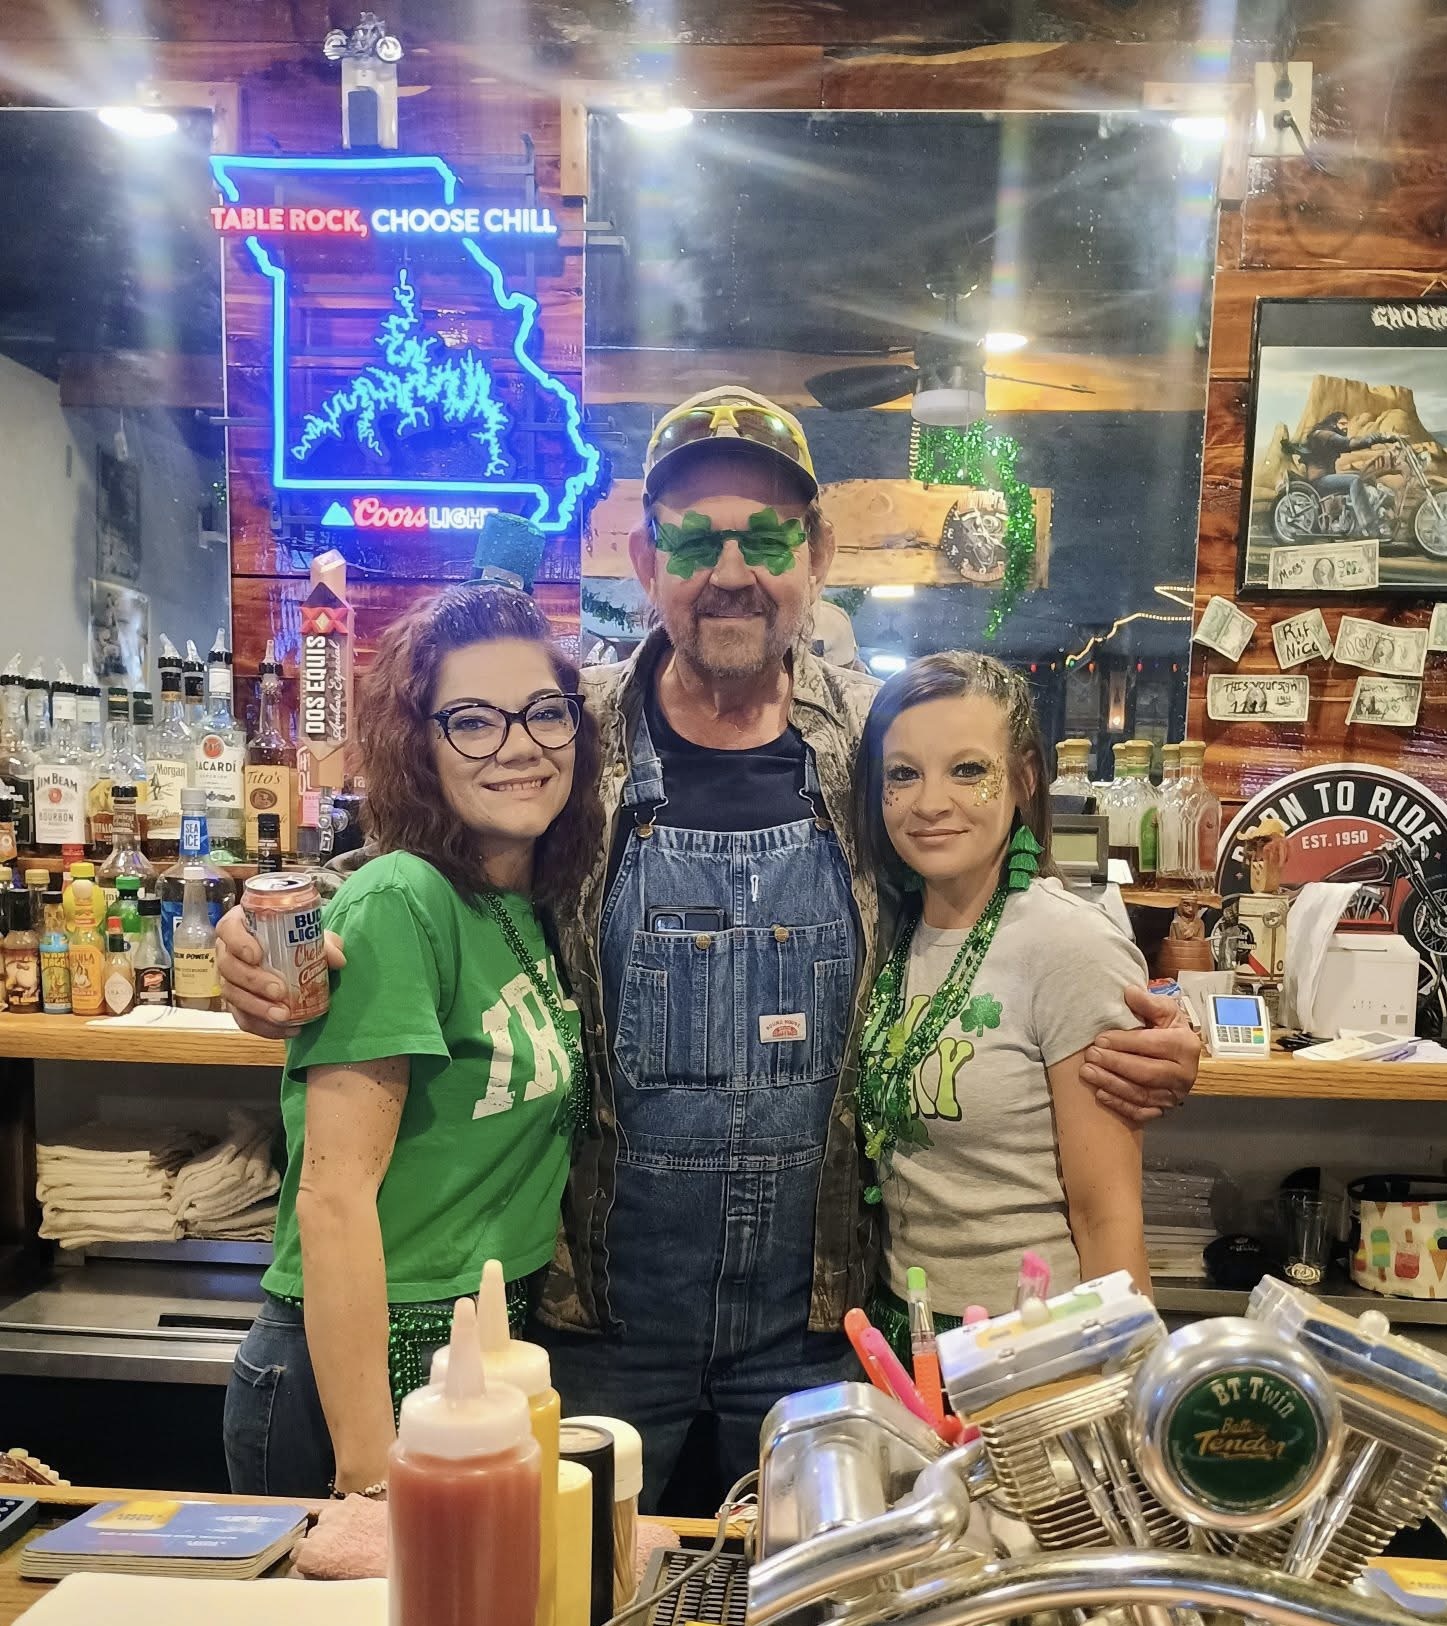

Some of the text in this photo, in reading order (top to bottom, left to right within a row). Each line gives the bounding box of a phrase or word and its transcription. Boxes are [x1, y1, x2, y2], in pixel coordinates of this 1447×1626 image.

[211, 208, 558, 237] TABLE ROCK, CHOOSE CHILL
[353, 497, 428, 527] Coors
[305, 636, 327, 734] DOS EQUIS
[156, 763, 186, 777] Morgan
[247, 770, 281, 784] Tito's
[36, 772, 78, 792] JIM BEAM
[1313, 781, 1355, 813] TO
[1368, 785, 1442, 849] RIDE
[185, 823, 199, 833] SEA
[185, 834, 199, 846] ICE
[1302, 830, 1369, 850] EST. 1950
[1193, 1428, 1287, 1459] Tender
